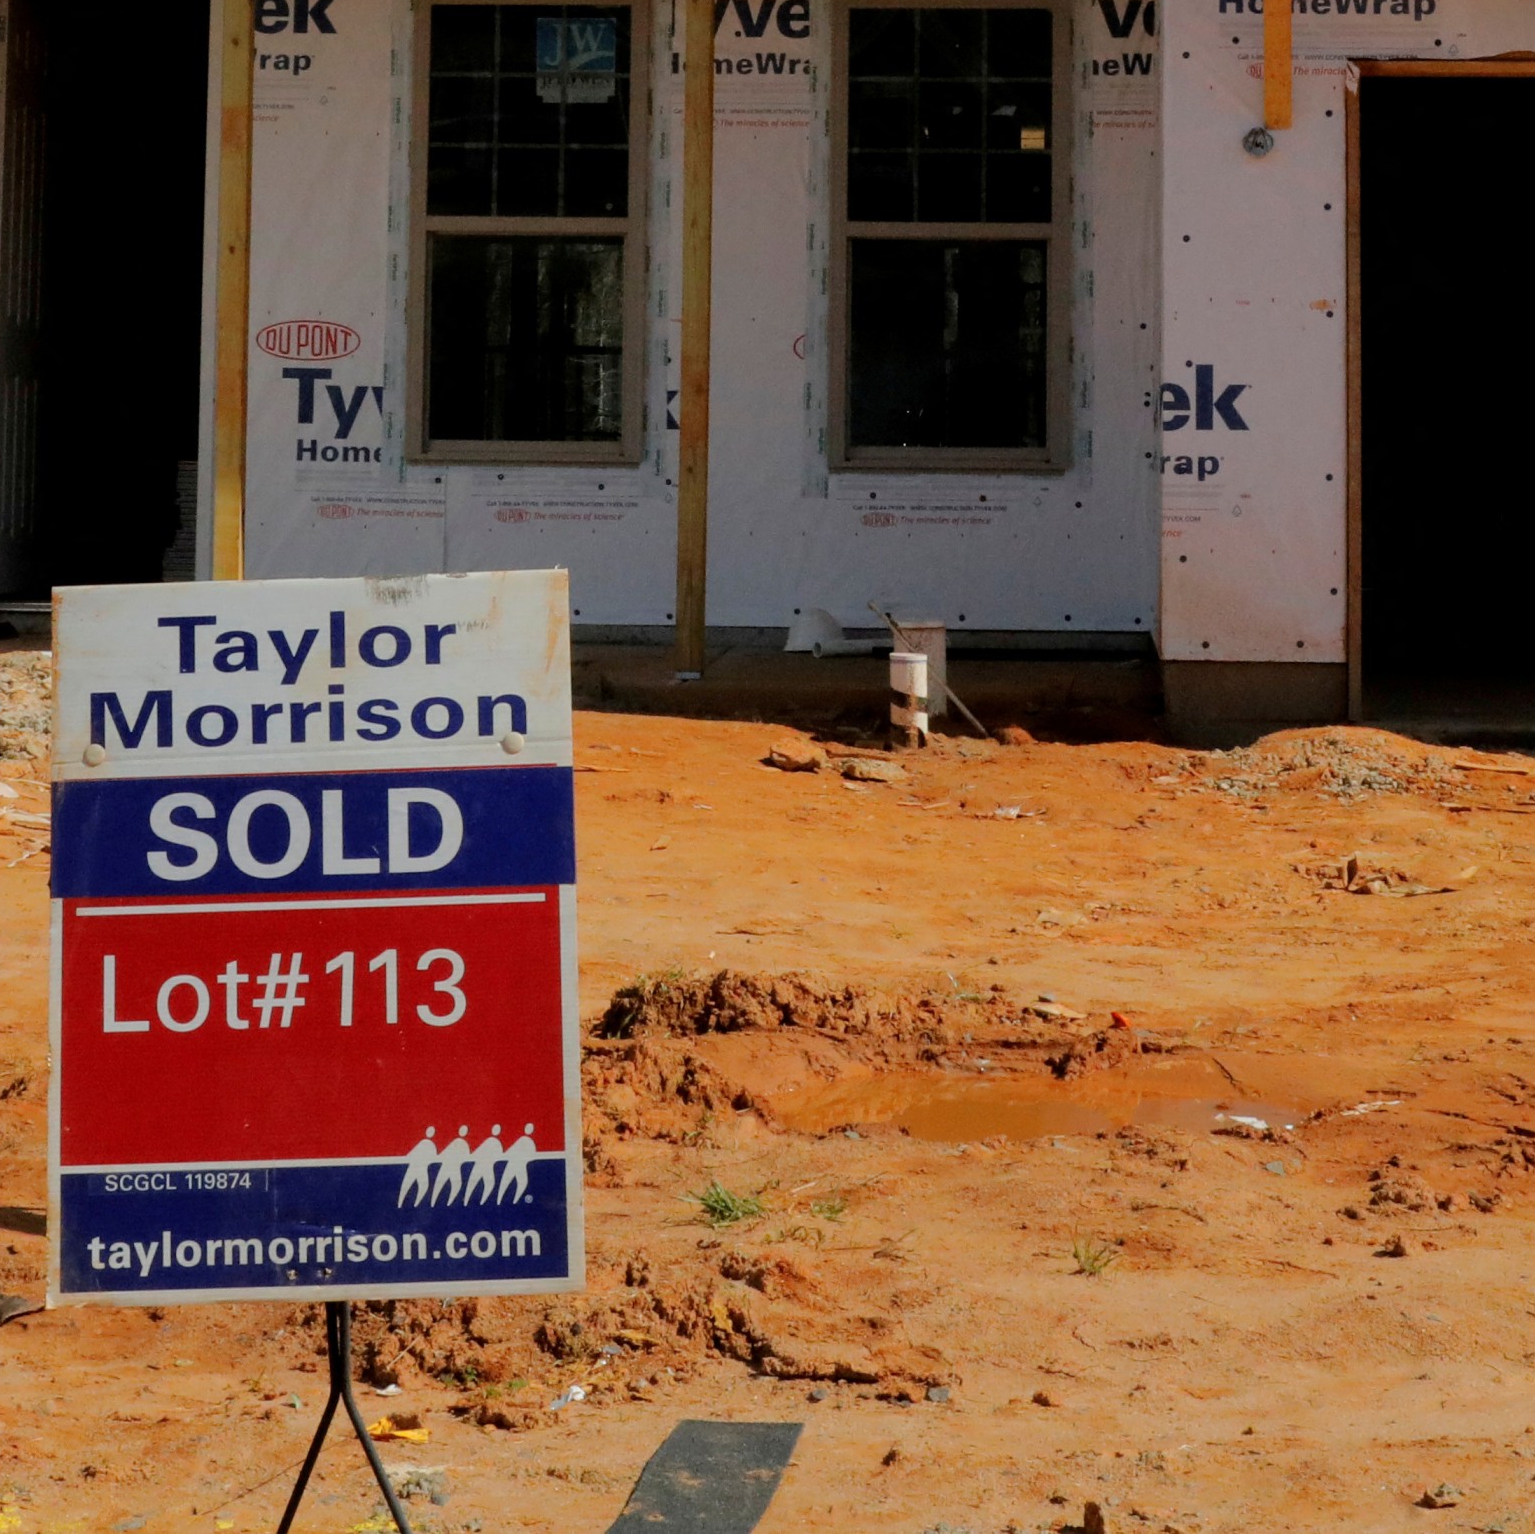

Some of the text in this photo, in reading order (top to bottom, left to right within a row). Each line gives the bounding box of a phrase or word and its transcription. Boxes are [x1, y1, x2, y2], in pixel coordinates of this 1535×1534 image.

[158, 611, 456, 685] Taylor
[91, 684, 527, 749] Morrison
[147, 787, 464, 881] SOLD
[105, 1172, 252, 1192] SCGCL 119874
[88, 1226, 541, 1277] taylormorrison.com
